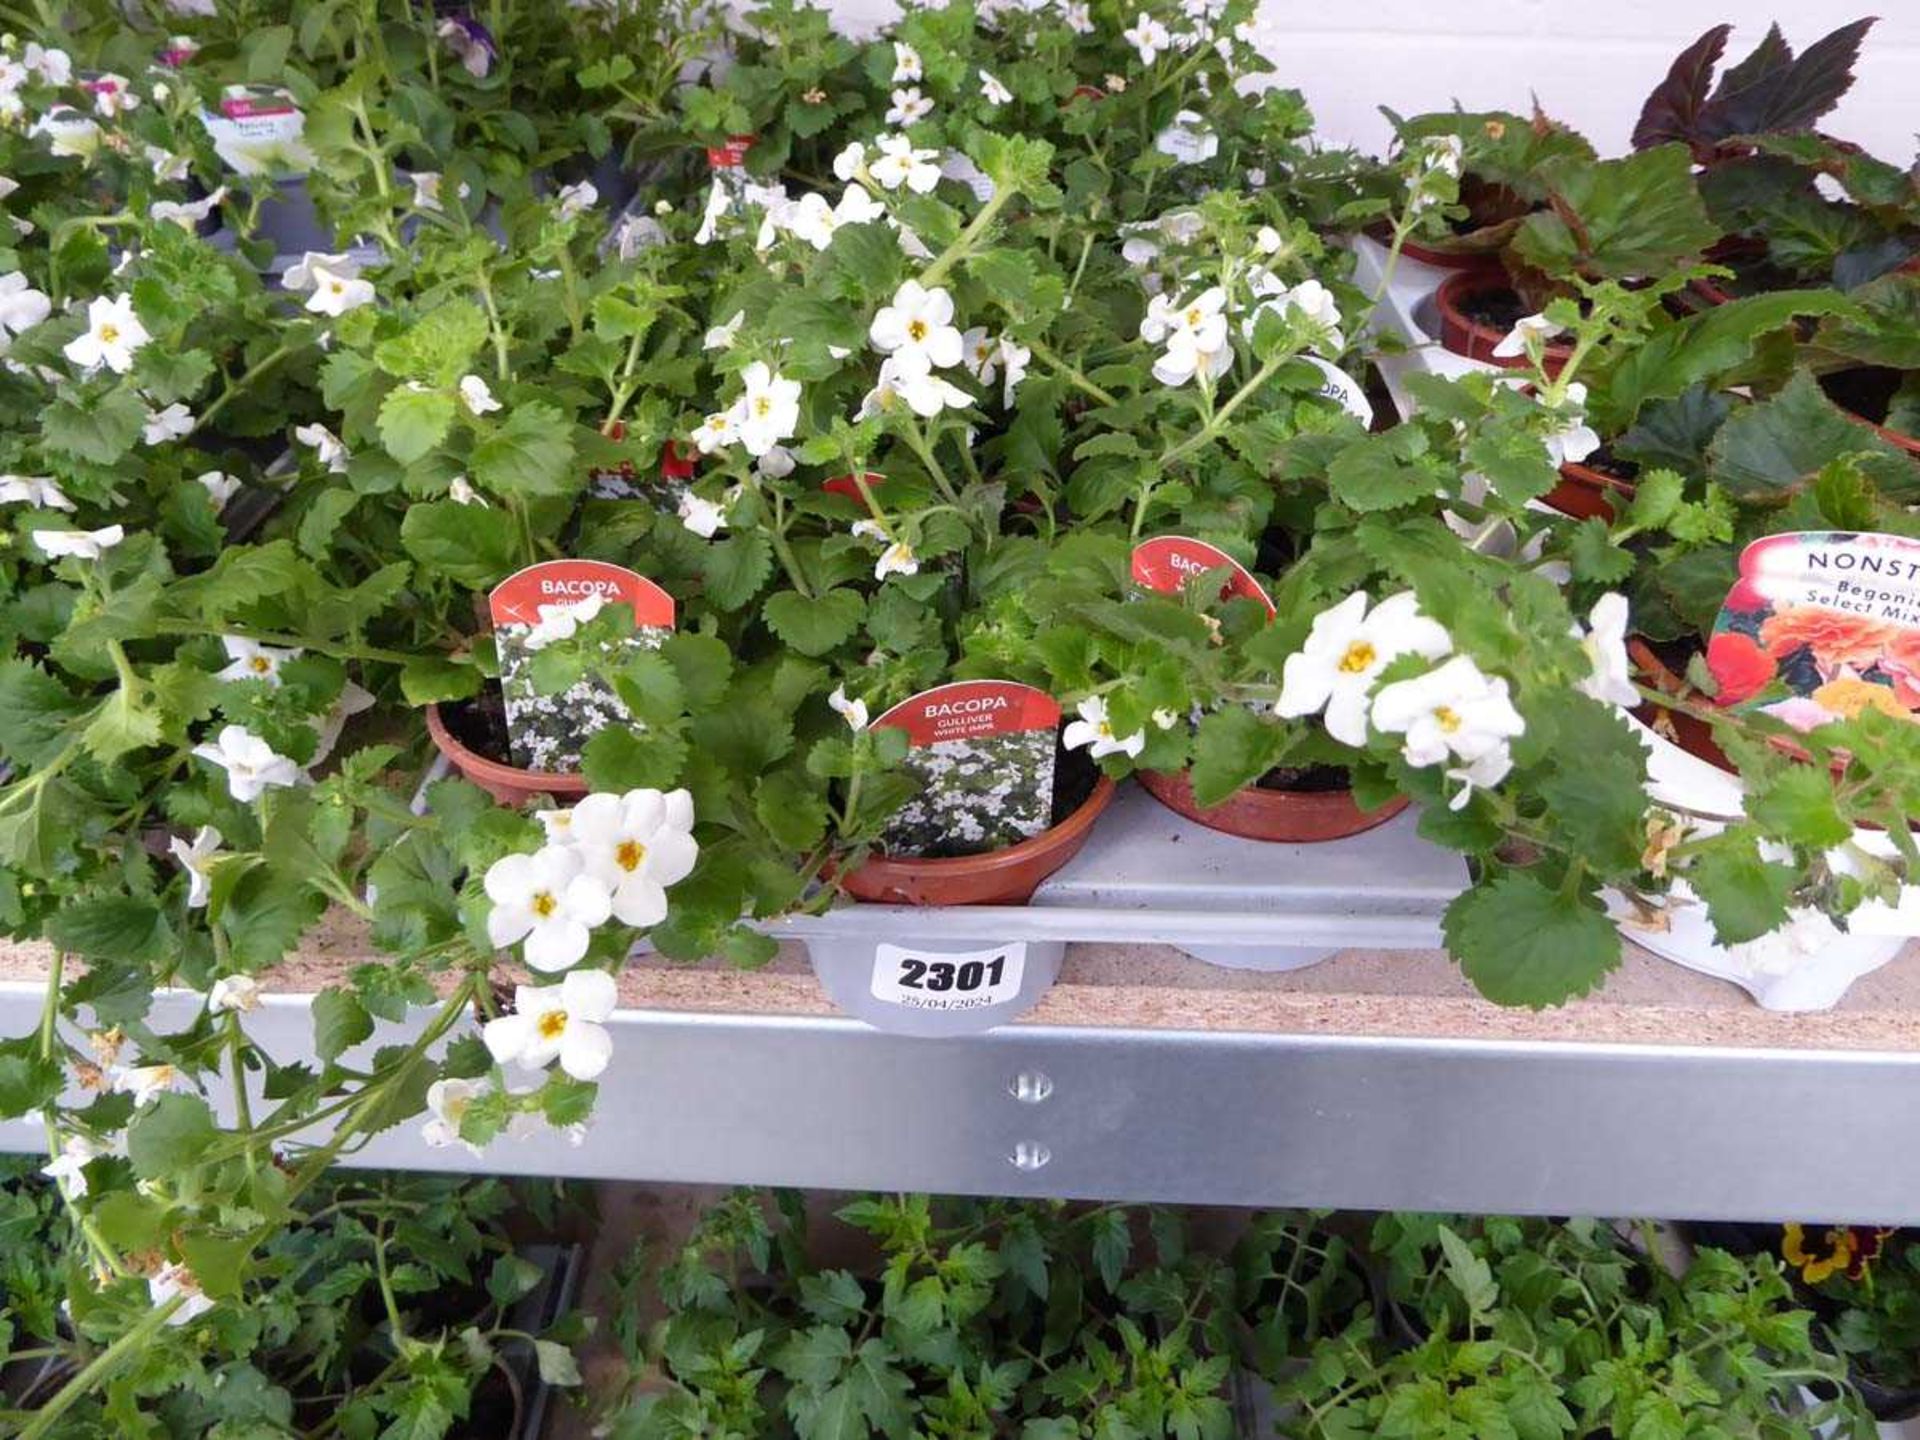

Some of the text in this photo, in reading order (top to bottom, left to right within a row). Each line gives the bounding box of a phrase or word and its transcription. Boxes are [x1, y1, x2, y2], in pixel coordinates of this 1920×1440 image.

[541, 580, 621, 595] BACOPA
[1807, 590, 1872, 613] Select
[925, 696, 1007, 717] BACOPA
[937, 713, 993, 729] GULLIVER
[934, 727, 967, 738] WHITE
[898, 955, 1005, 991] 2301
[901, 994, 994, 1010] 25/04/2024
